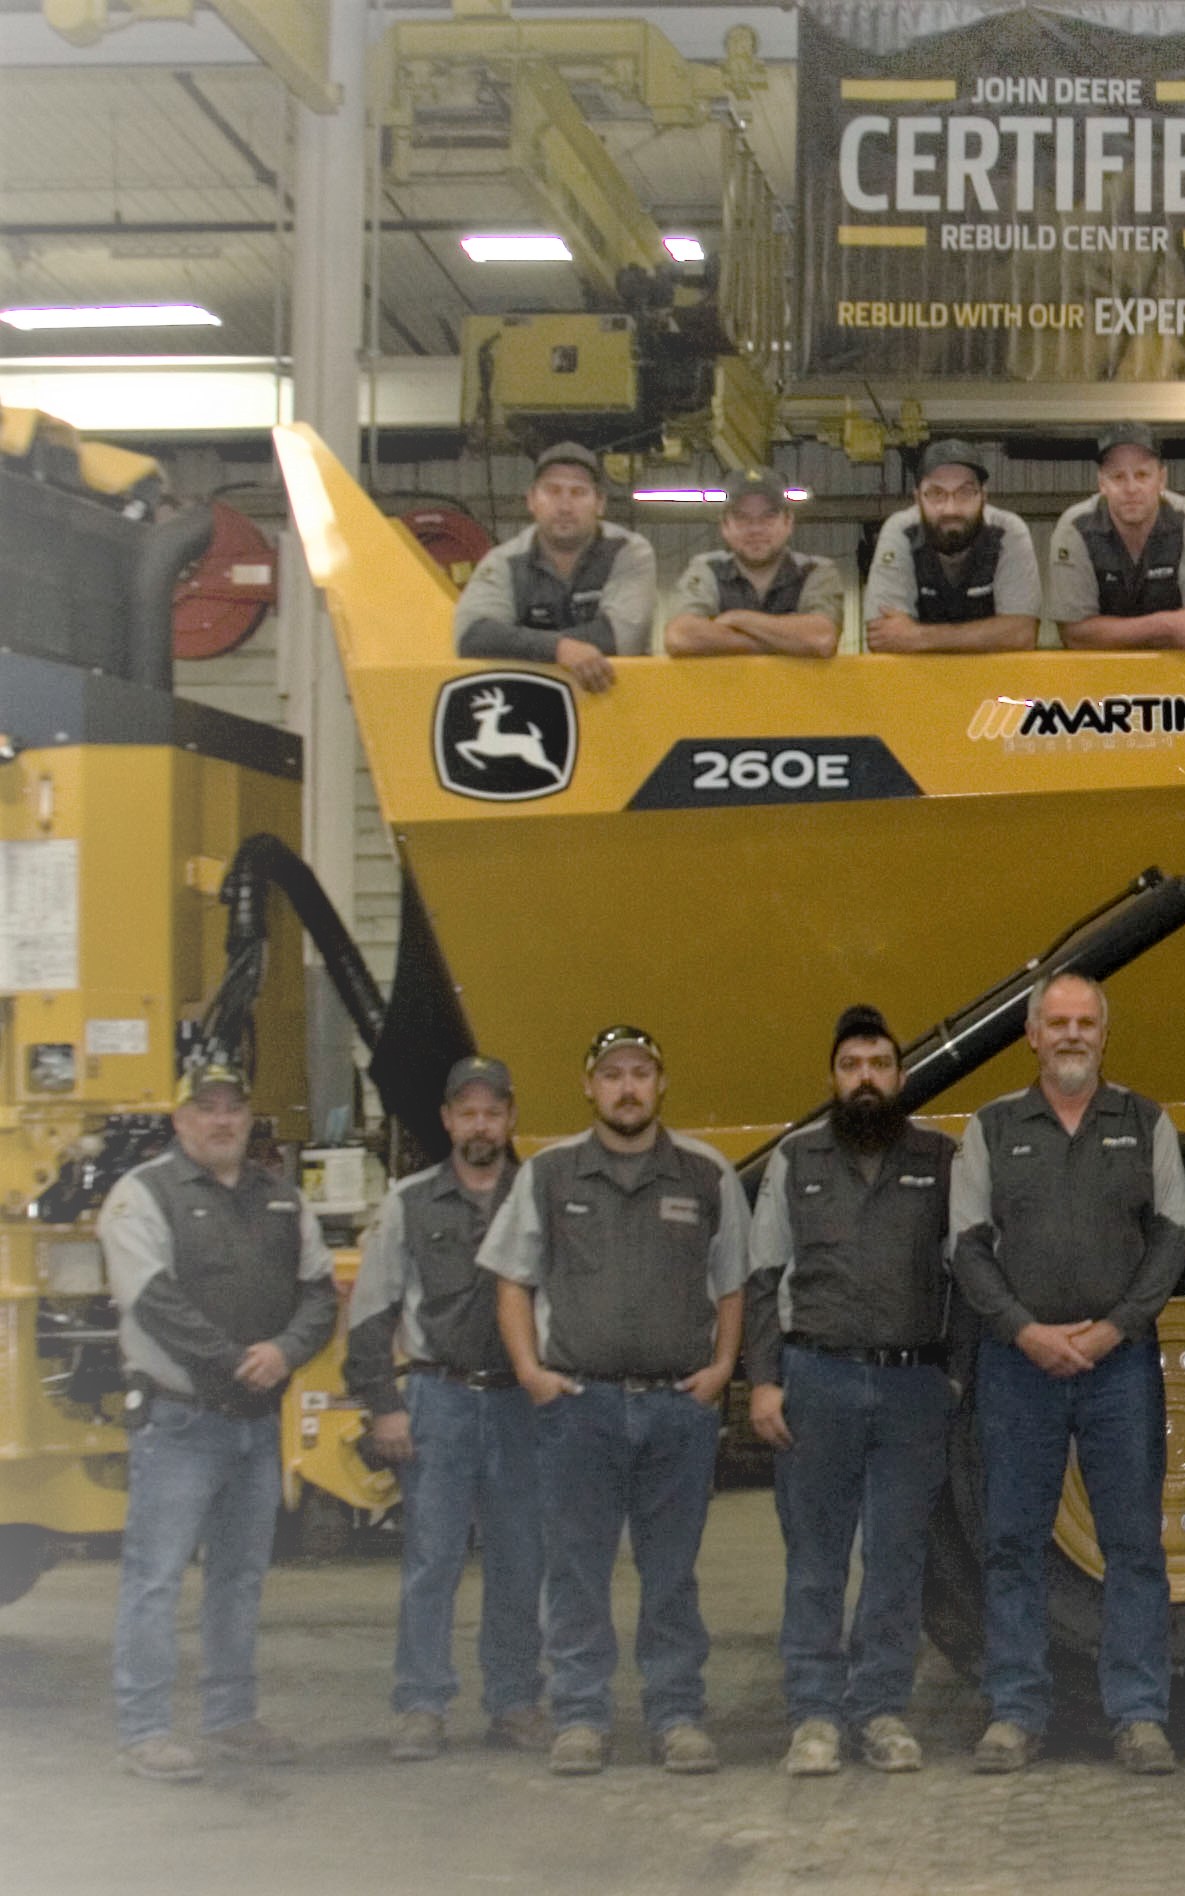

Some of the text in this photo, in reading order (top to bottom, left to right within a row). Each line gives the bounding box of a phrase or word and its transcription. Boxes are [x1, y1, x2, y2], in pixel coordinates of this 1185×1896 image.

[971, 77, 1142, 105] JOHN DEERE
[941, 225, 1169, 252] REBUILD CENTER
[838, 302, 947, 328] REBUILD
[954, 303, 1022, 328] WITH
[1028, 303, 1085, 329] OUR
[693, 751, 850, 789] 260E
